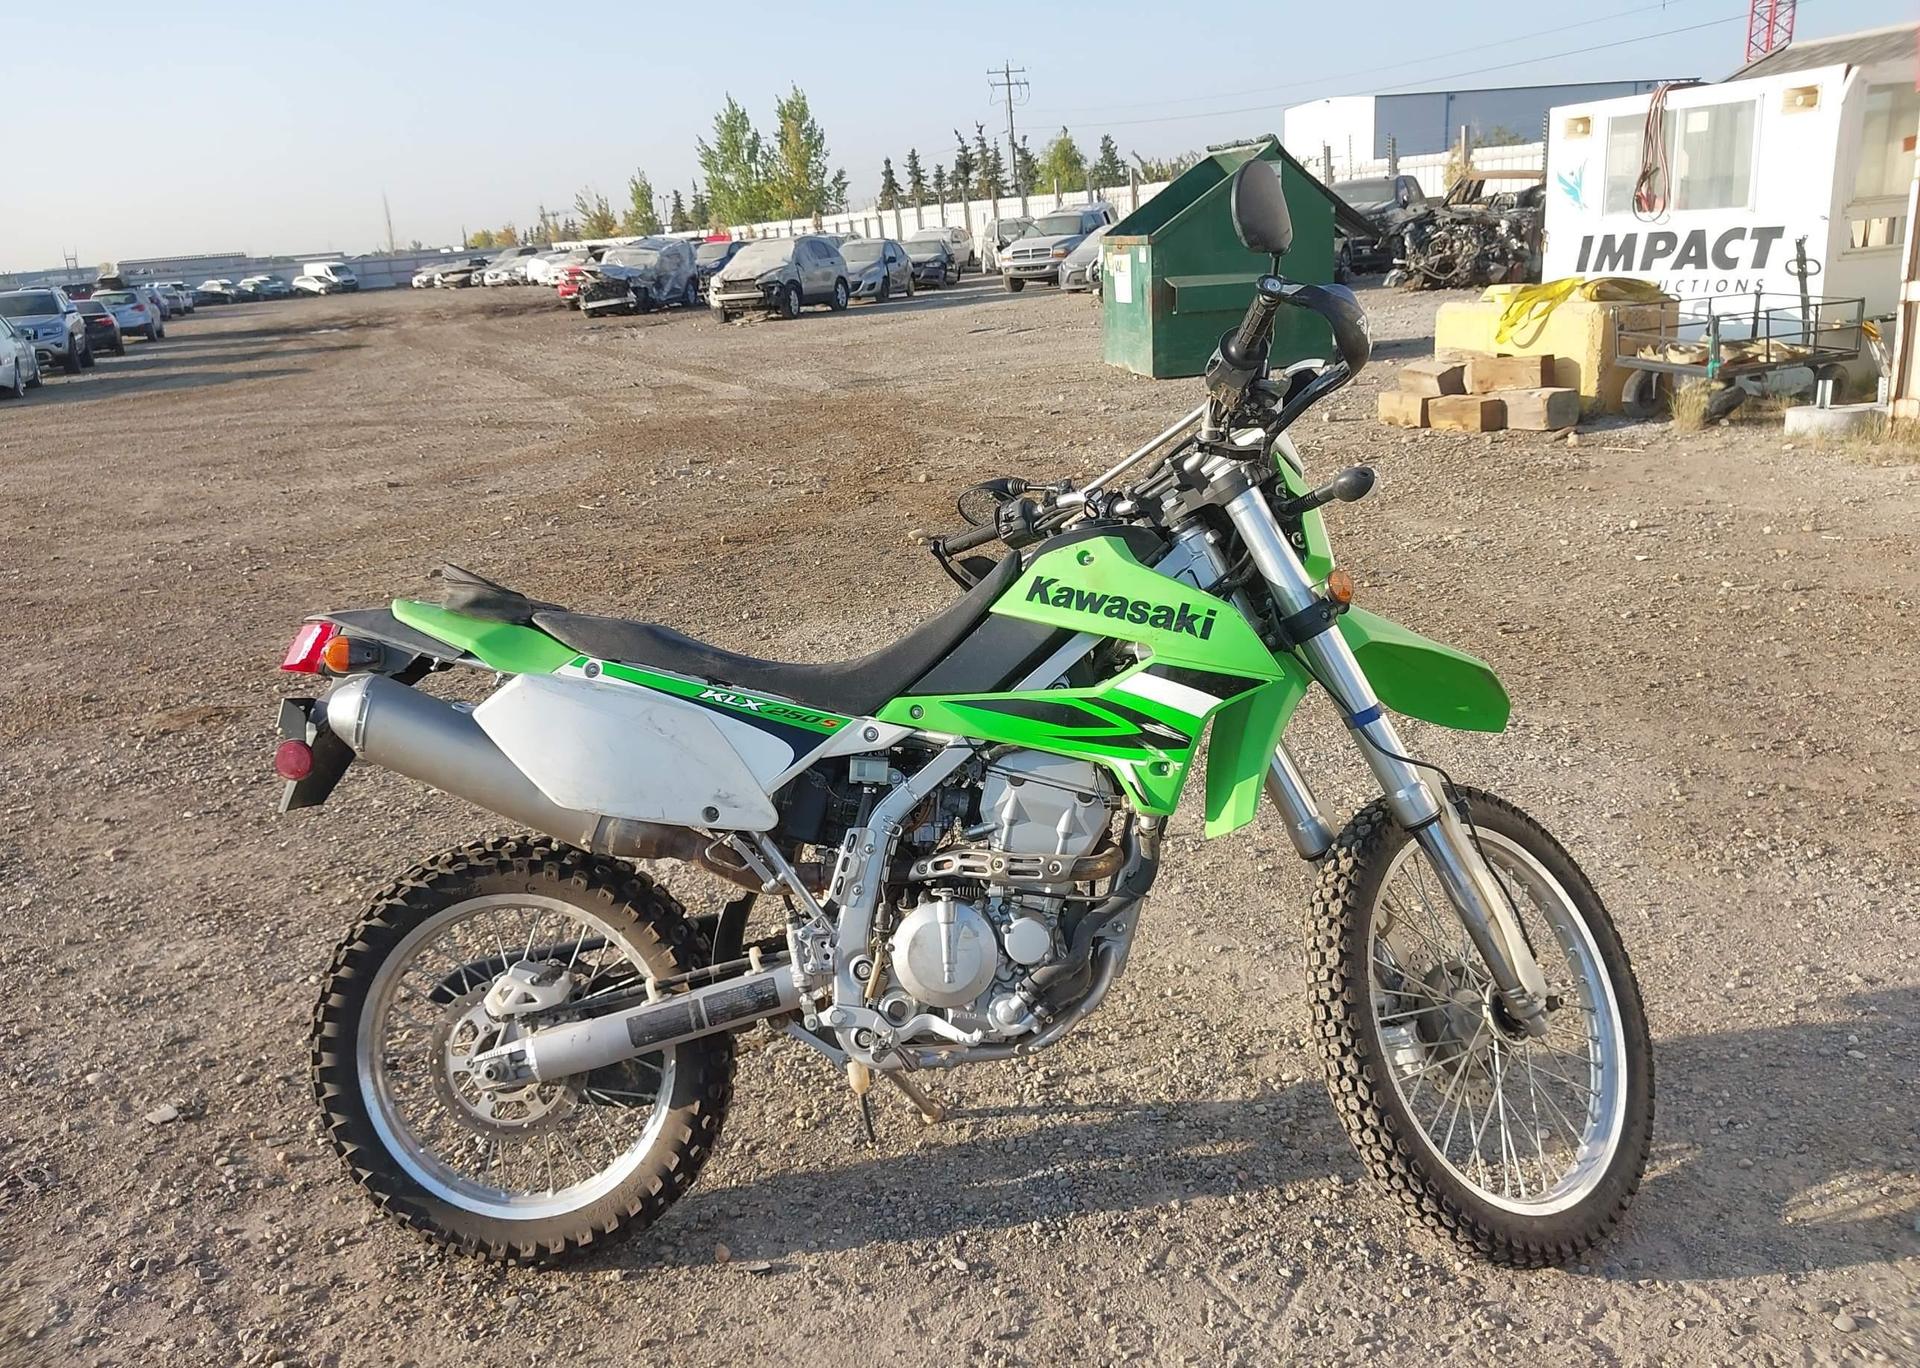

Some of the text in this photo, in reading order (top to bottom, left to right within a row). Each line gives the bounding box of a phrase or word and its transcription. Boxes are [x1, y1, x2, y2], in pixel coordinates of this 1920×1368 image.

[1576, 226, 1785, 272] IMPACT
[1658, 278, 1764, 294] UCTIONS
[1026, 576, 1217, 640] Kawasaki
[700, 689, 766, 712] KLX
